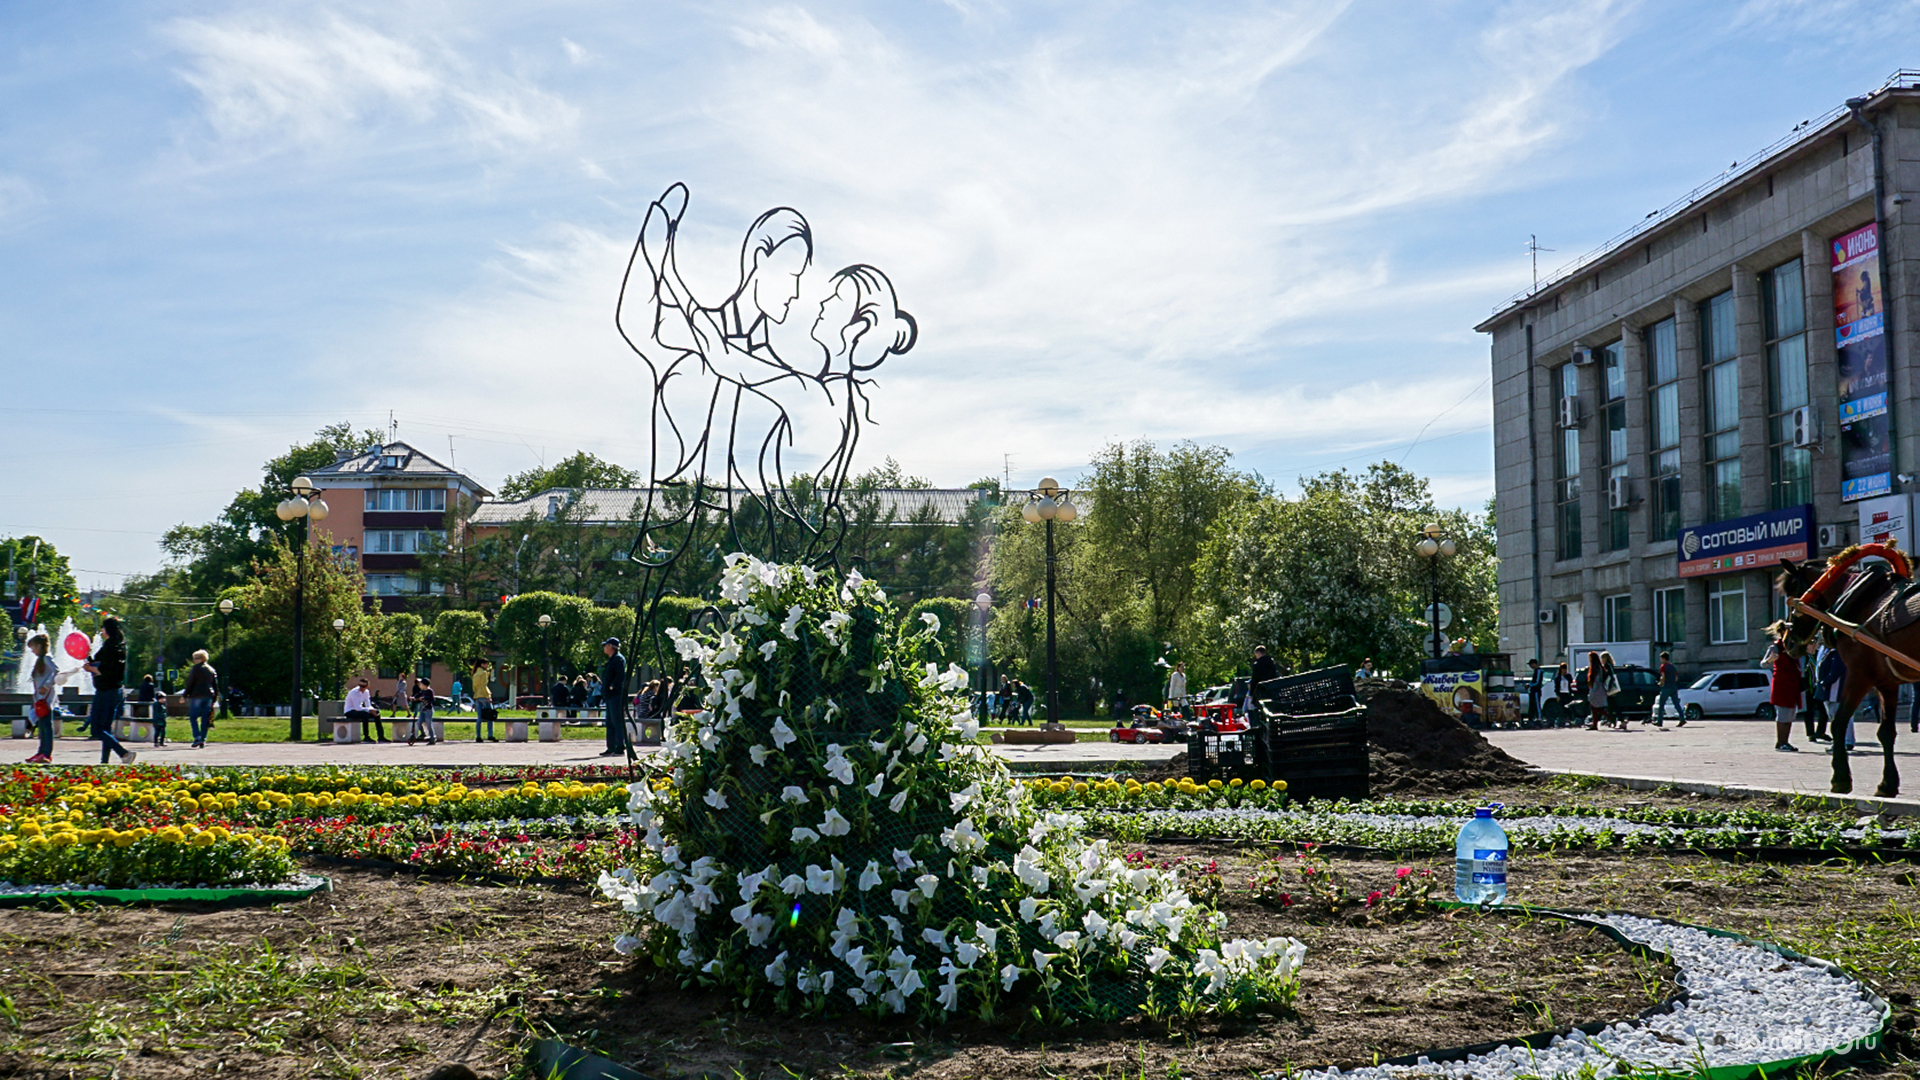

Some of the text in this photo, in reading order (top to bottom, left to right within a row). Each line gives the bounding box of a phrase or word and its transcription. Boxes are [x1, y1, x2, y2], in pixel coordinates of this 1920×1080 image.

[1847, 229, 1877, 257] ИЮНЬ
[1857, 474, 1887, 492] 22 ИЮНЯ
[1701, 518, 1803, 550] СОТОВЫЙ МИР
[1423, 673, 1459, 684] Живой
[1433, 684, 1455, 693] квас
